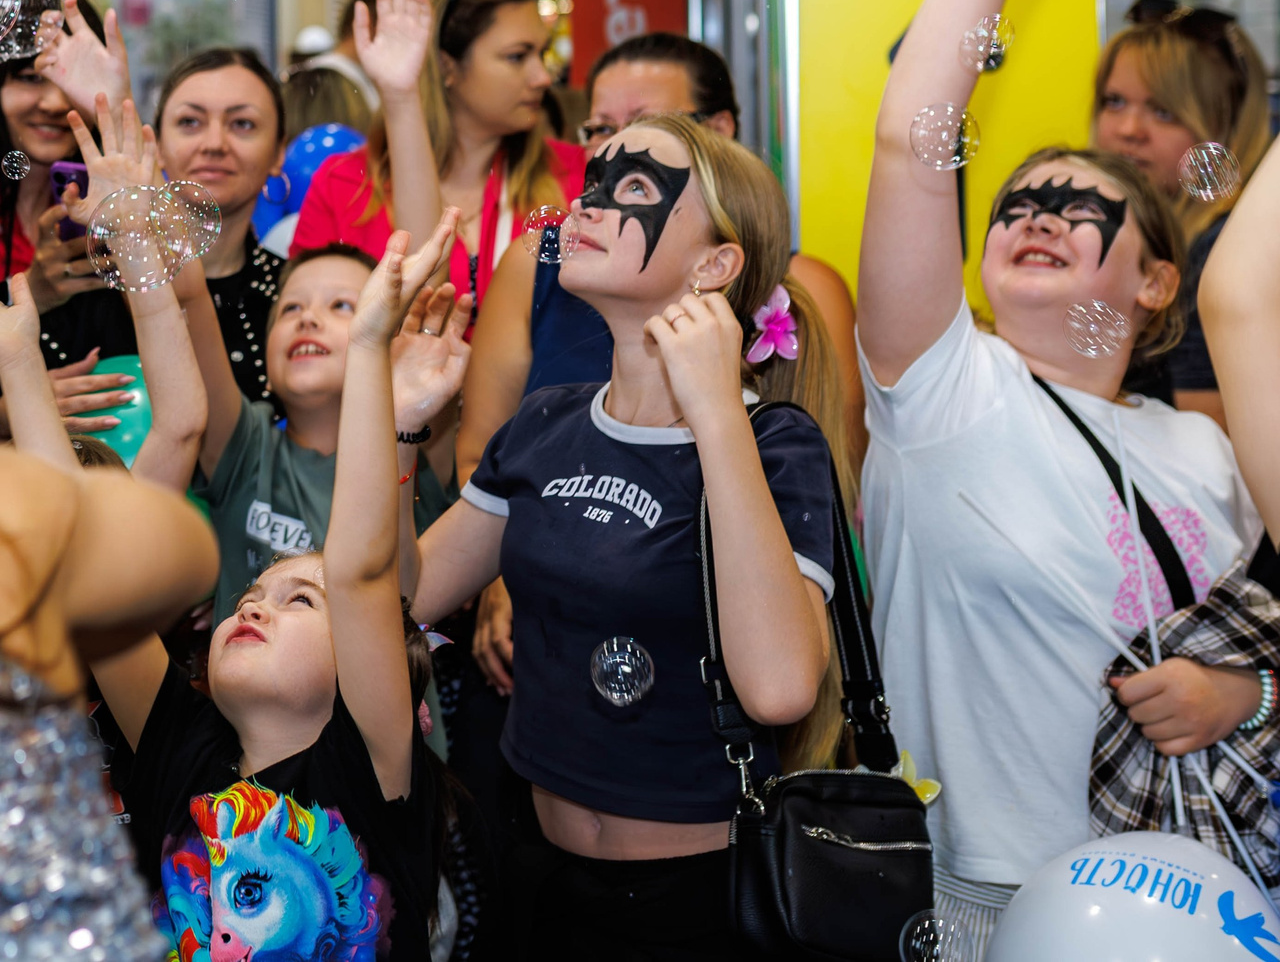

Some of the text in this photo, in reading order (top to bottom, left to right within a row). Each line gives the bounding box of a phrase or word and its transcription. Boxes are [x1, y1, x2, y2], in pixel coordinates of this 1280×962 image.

[541, 475, 663, 530] COLORADO
[583, 505, 614, 524] 1876
[1070, 857, 1203, 916] ЮНОСТЬ
